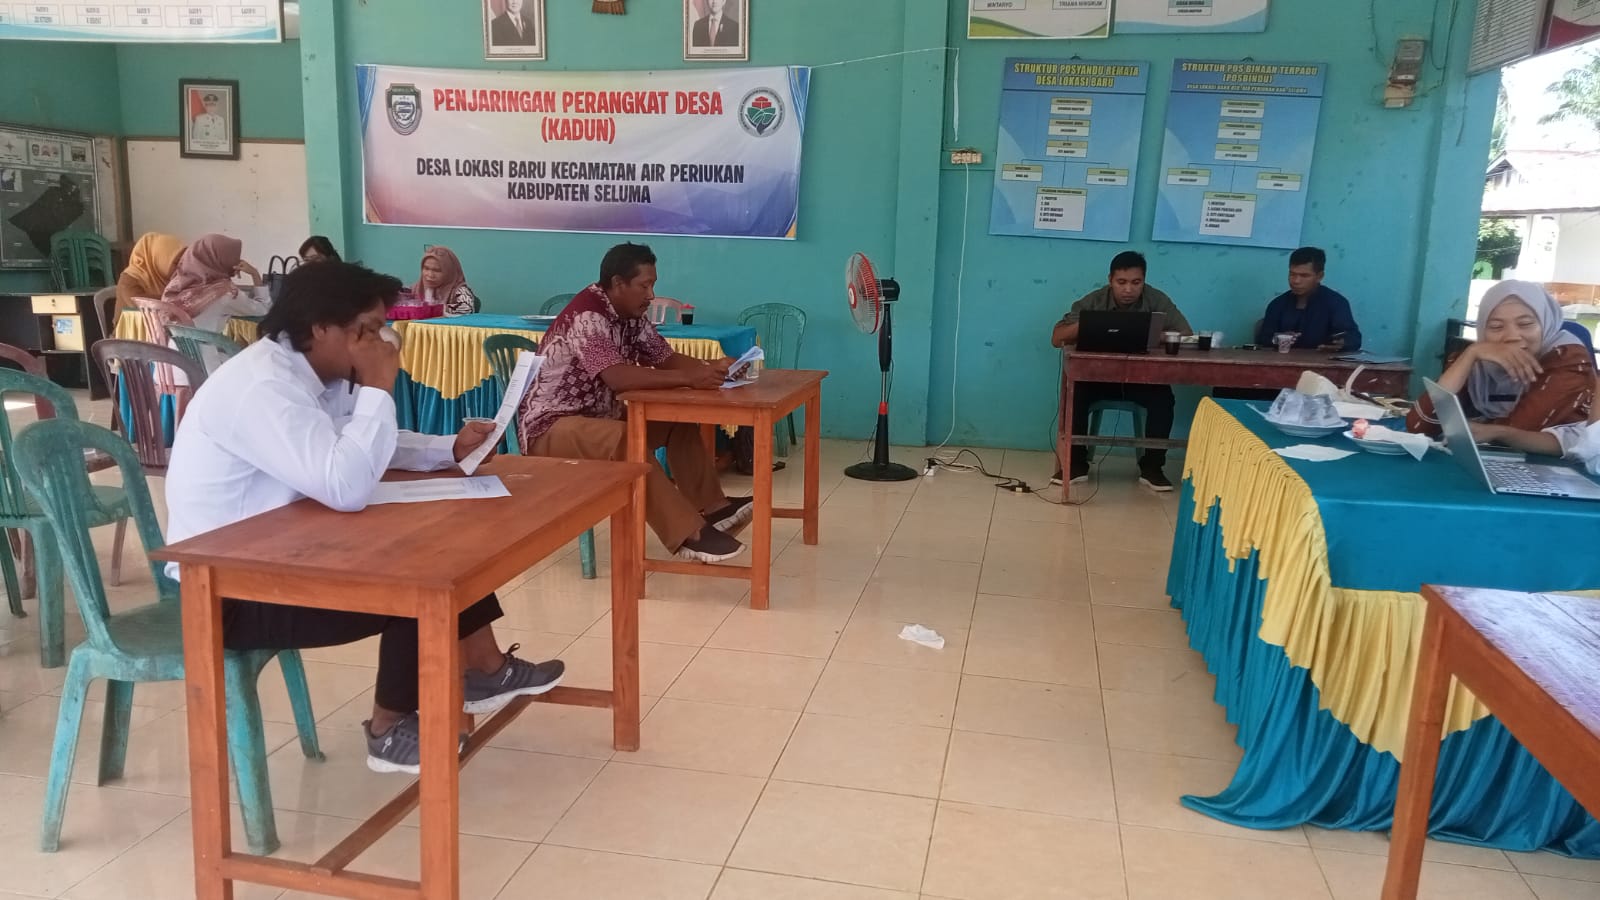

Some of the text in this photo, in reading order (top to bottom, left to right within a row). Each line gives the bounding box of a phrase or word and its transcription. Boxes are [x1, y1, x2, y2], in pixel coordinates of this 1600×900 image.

[1014, 63, 1139, 76] STRUKTUR POSYANDU REMAJA
[1182, 63, 1225, 72] STRUKTUR
[1227, 64, 1243, 73] POS
[1035, 75, 1115, 87] DESA LOKASI BARU
[433, 88, 556, 113] PENJARINGAN
[562, 90, 668, 114] PERANGKAT
[675, 91, 723, 115] DESA
[541, 116, 616, 144] (KADUN)
[417, 158, 745, 184] DESA LOKASI BARU KECAMATAN AIR PERIUKAN
[508, 182, 651, 203] KABUPATEN SELUMA
